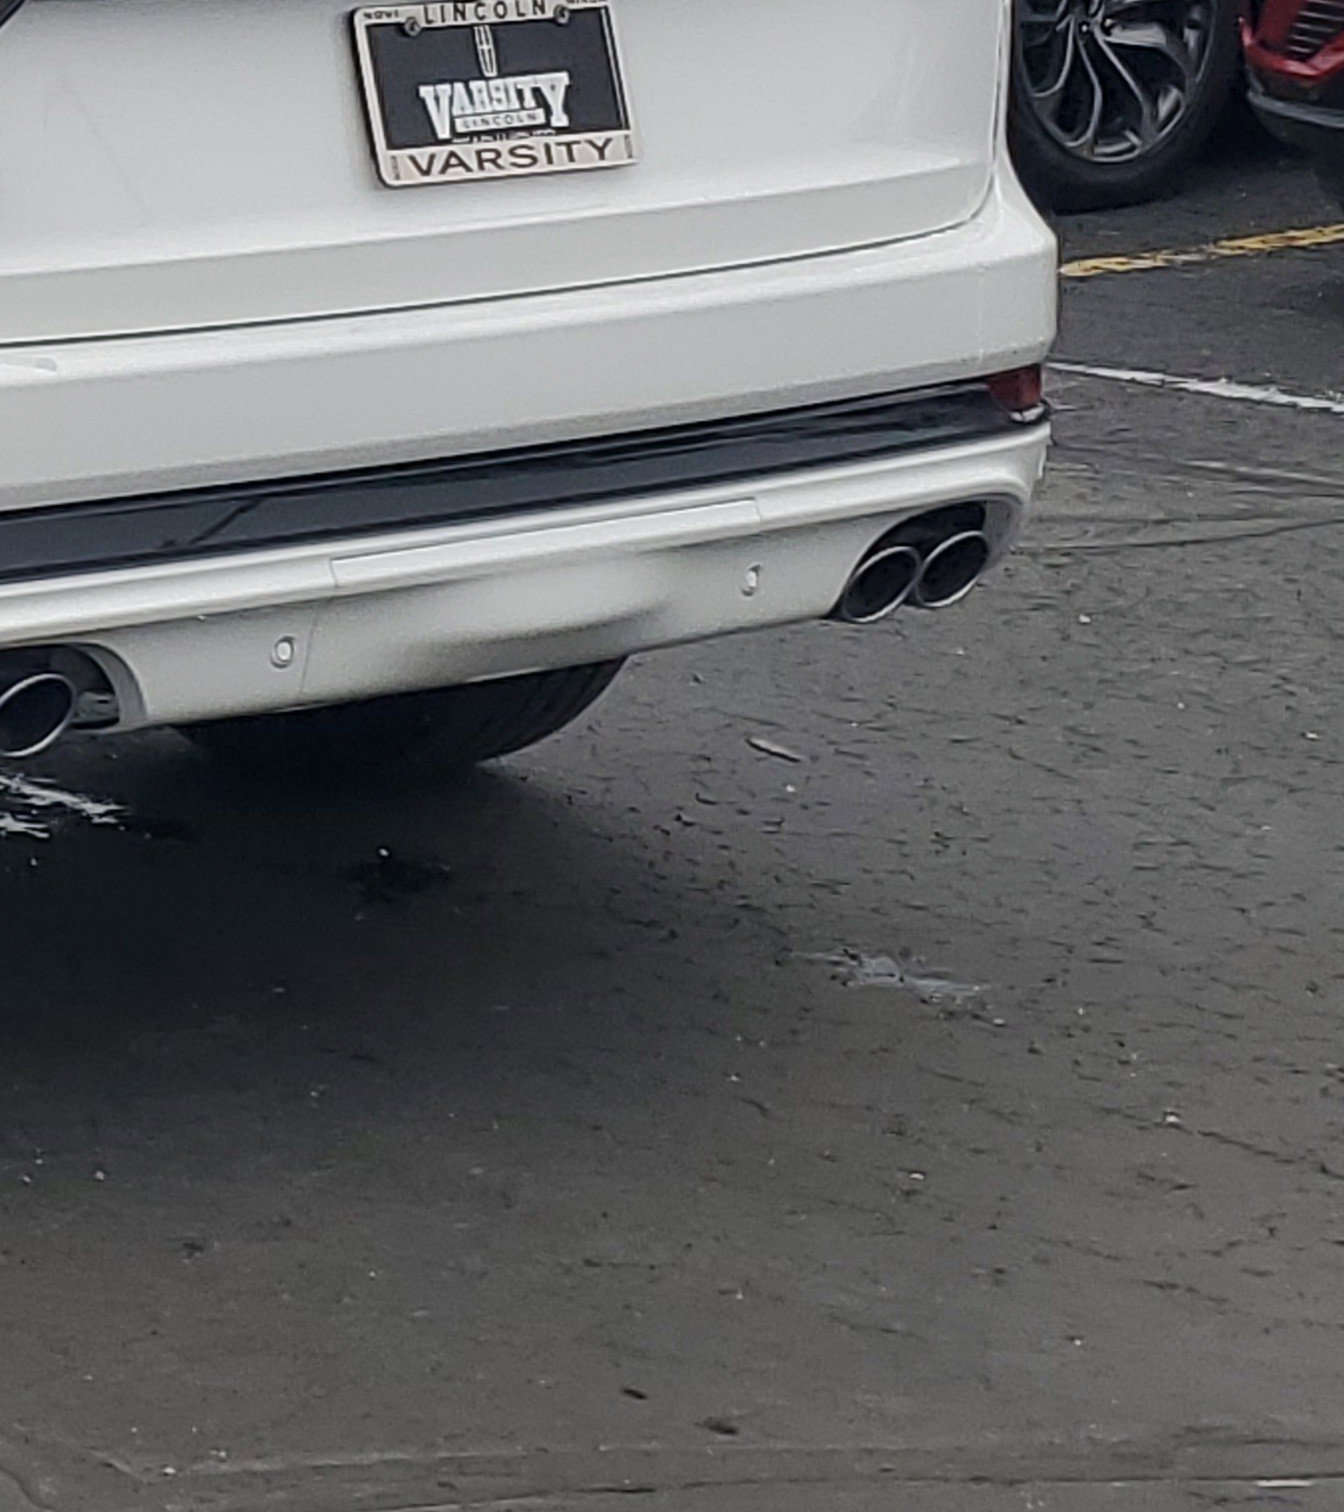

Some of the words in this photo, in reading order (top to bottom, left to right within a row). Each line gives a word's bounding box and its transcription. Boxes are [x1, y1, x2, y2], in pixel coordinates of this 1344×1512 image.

[418, 71, 571, 140] VARSITY
[461, 112, 539, 130] LINCOLN
[408, 136, 614, 178] VARSITY
